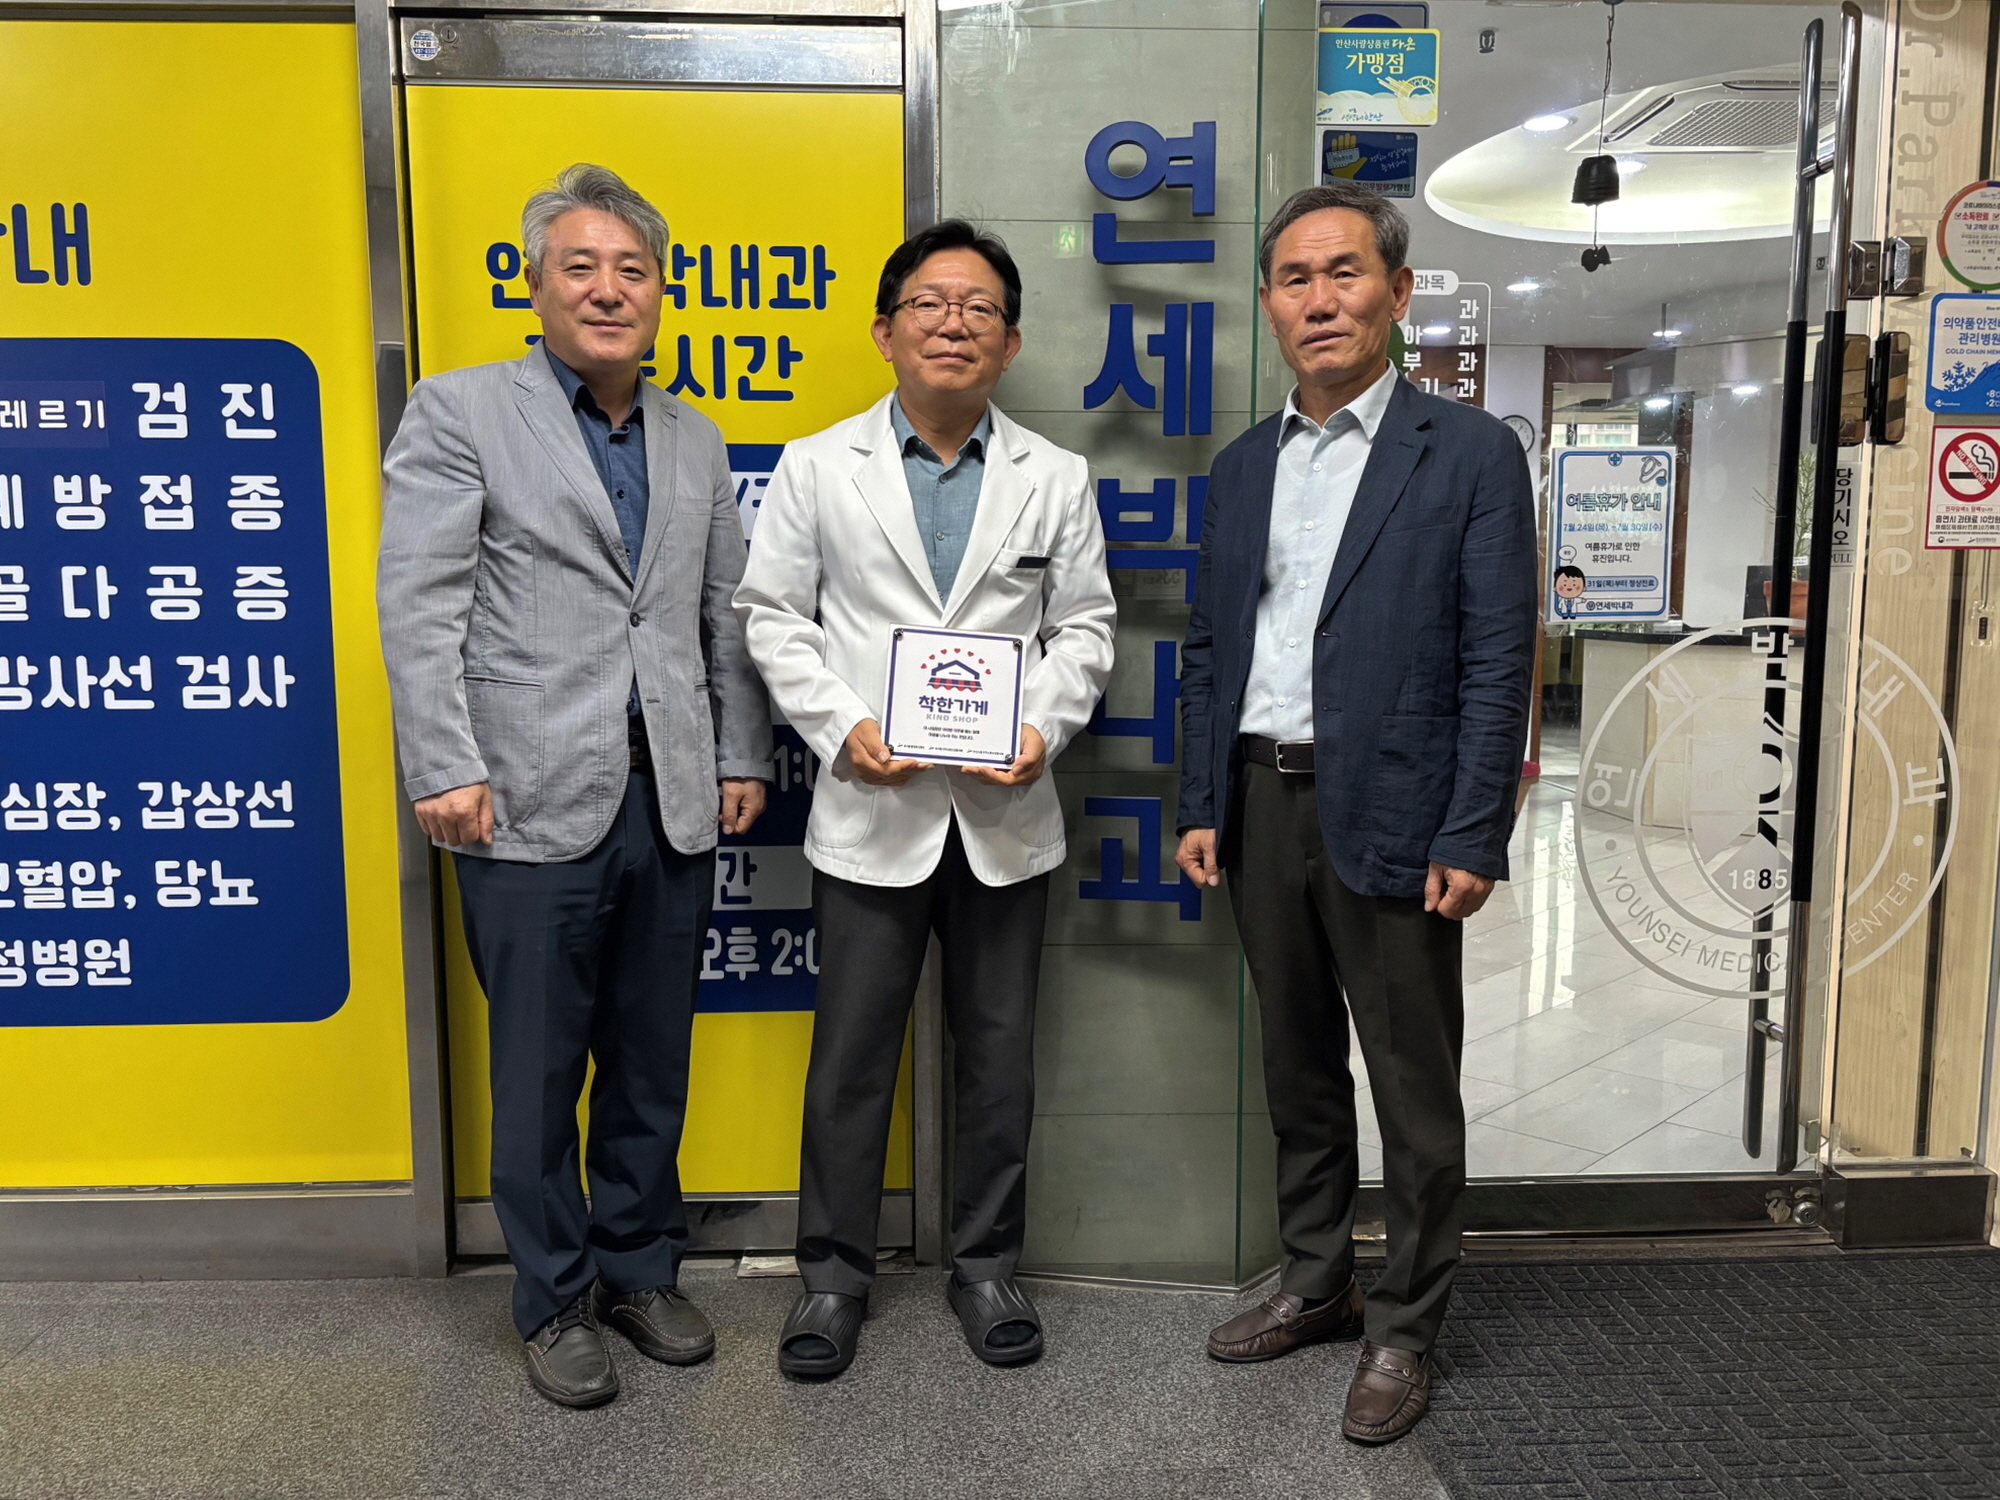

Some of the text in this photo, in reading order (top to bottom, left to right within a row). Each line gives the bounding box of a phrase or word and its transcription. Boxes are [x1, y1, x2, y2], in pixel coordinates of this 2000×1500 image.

[1335, 36, 1416, 51] 안산사랑상품권 다온
[1345, 52, 1405, 75] 가맹점
[0, 202, 92, 286] 내
[1414, 274, 1446, 291] 과목
[1956, 449, 1988, 486] NO SMOKING
[1565, 492, 1662, 512] 여름휴가 안내
[1831, 467, 1854, 547] 당기시오
[1957, 515, 1978, 524] 과태료
[1584, 542, 1640, 551] 여름휴가로 인한
[1591, 554, 1633, 563] 휴진입니다.
[1831, 553, 1853, 563] ULL
[1628, 579, 1655, 588] 정상진료
[1595, 601, 1634, 610] 연세박내과
[176, 655, 296, 710] 검사
[918, 695, 989, 716] 착한가게
[926, 713, 979, 724] KIND SHOP
[2, 780, 295, 832] 심장, 갑상선
[155, 860, 260, 909] 당뇨
[1728, 868, 1788, 890] 1885
[1606, 865, 1693, 958] YOUNSEI
[1697, 944, 1787, 976] MEDIC
